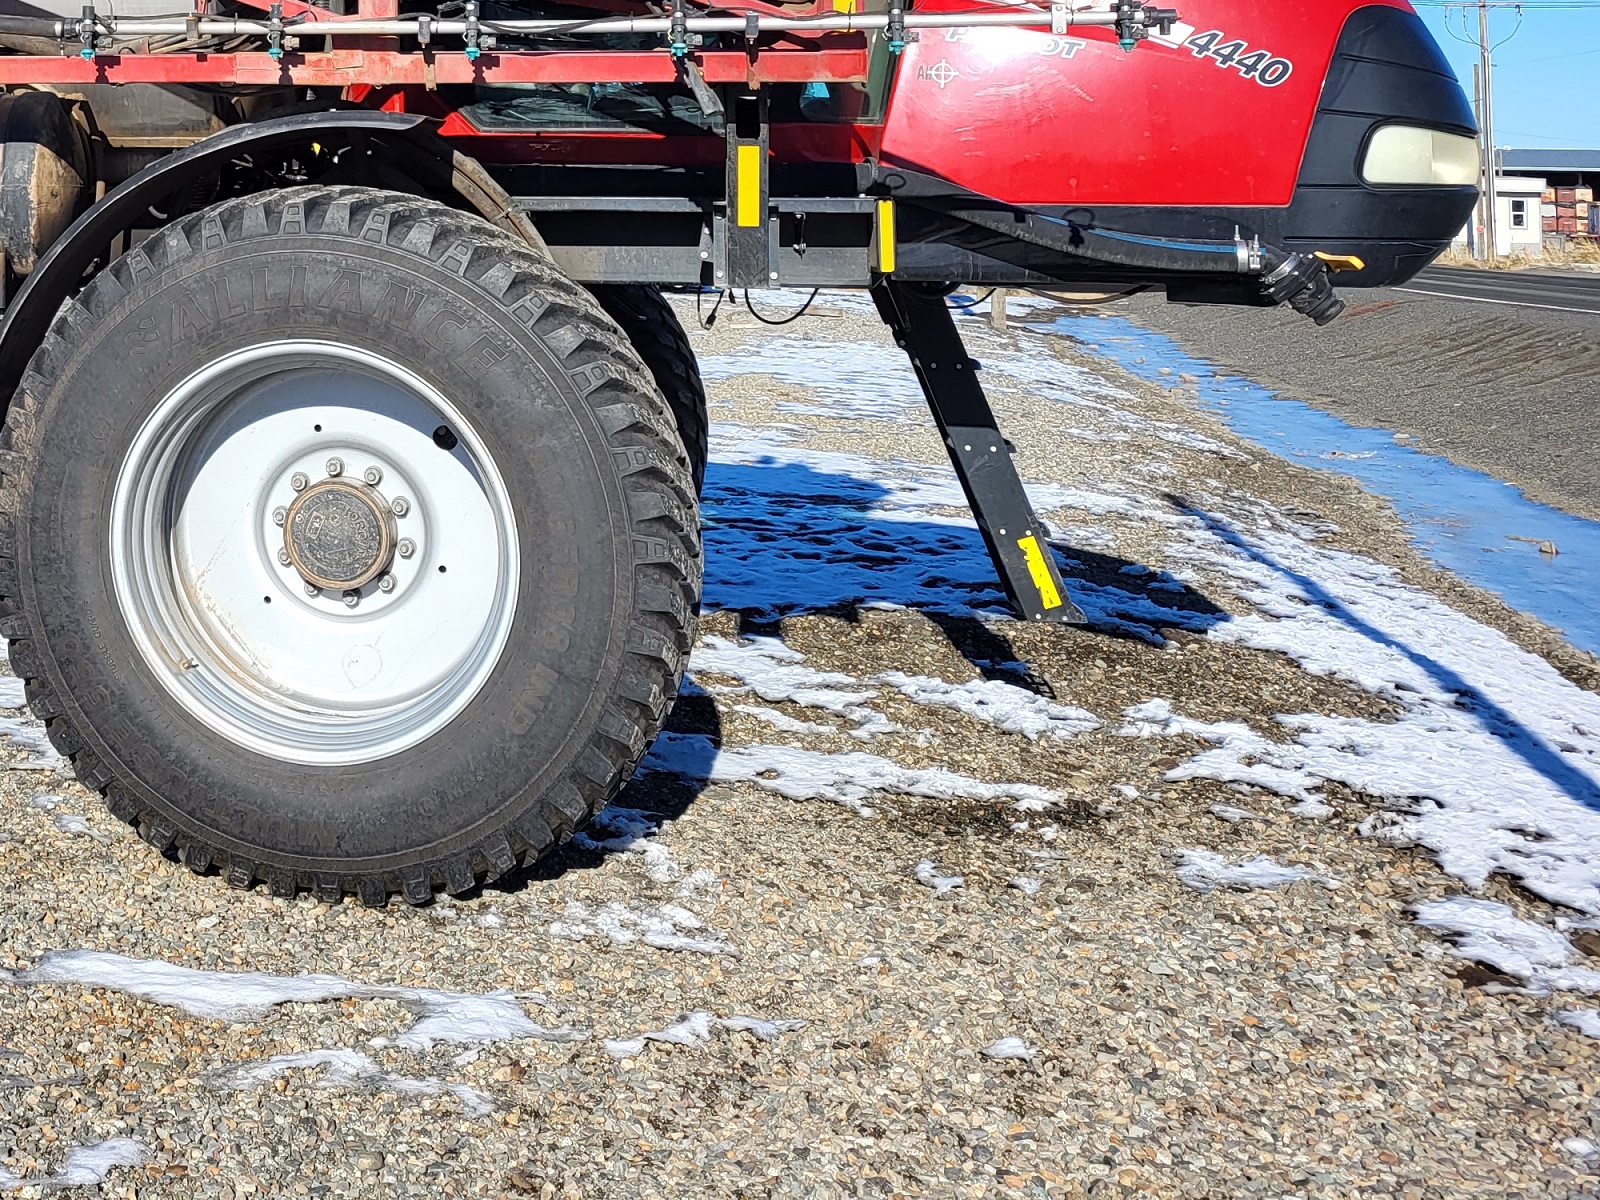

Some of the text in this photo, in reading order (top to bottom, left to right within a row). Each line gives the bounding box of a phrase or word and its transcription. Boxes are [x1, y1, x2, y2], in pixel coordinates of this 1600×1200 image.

[1187, 31, 1293, 87] 4440
[170, 265, 510, 383] ALLIANCE
[85, 608, 120, 681] STUBBLE GUARD
[506, 661, 560, 737] IND
